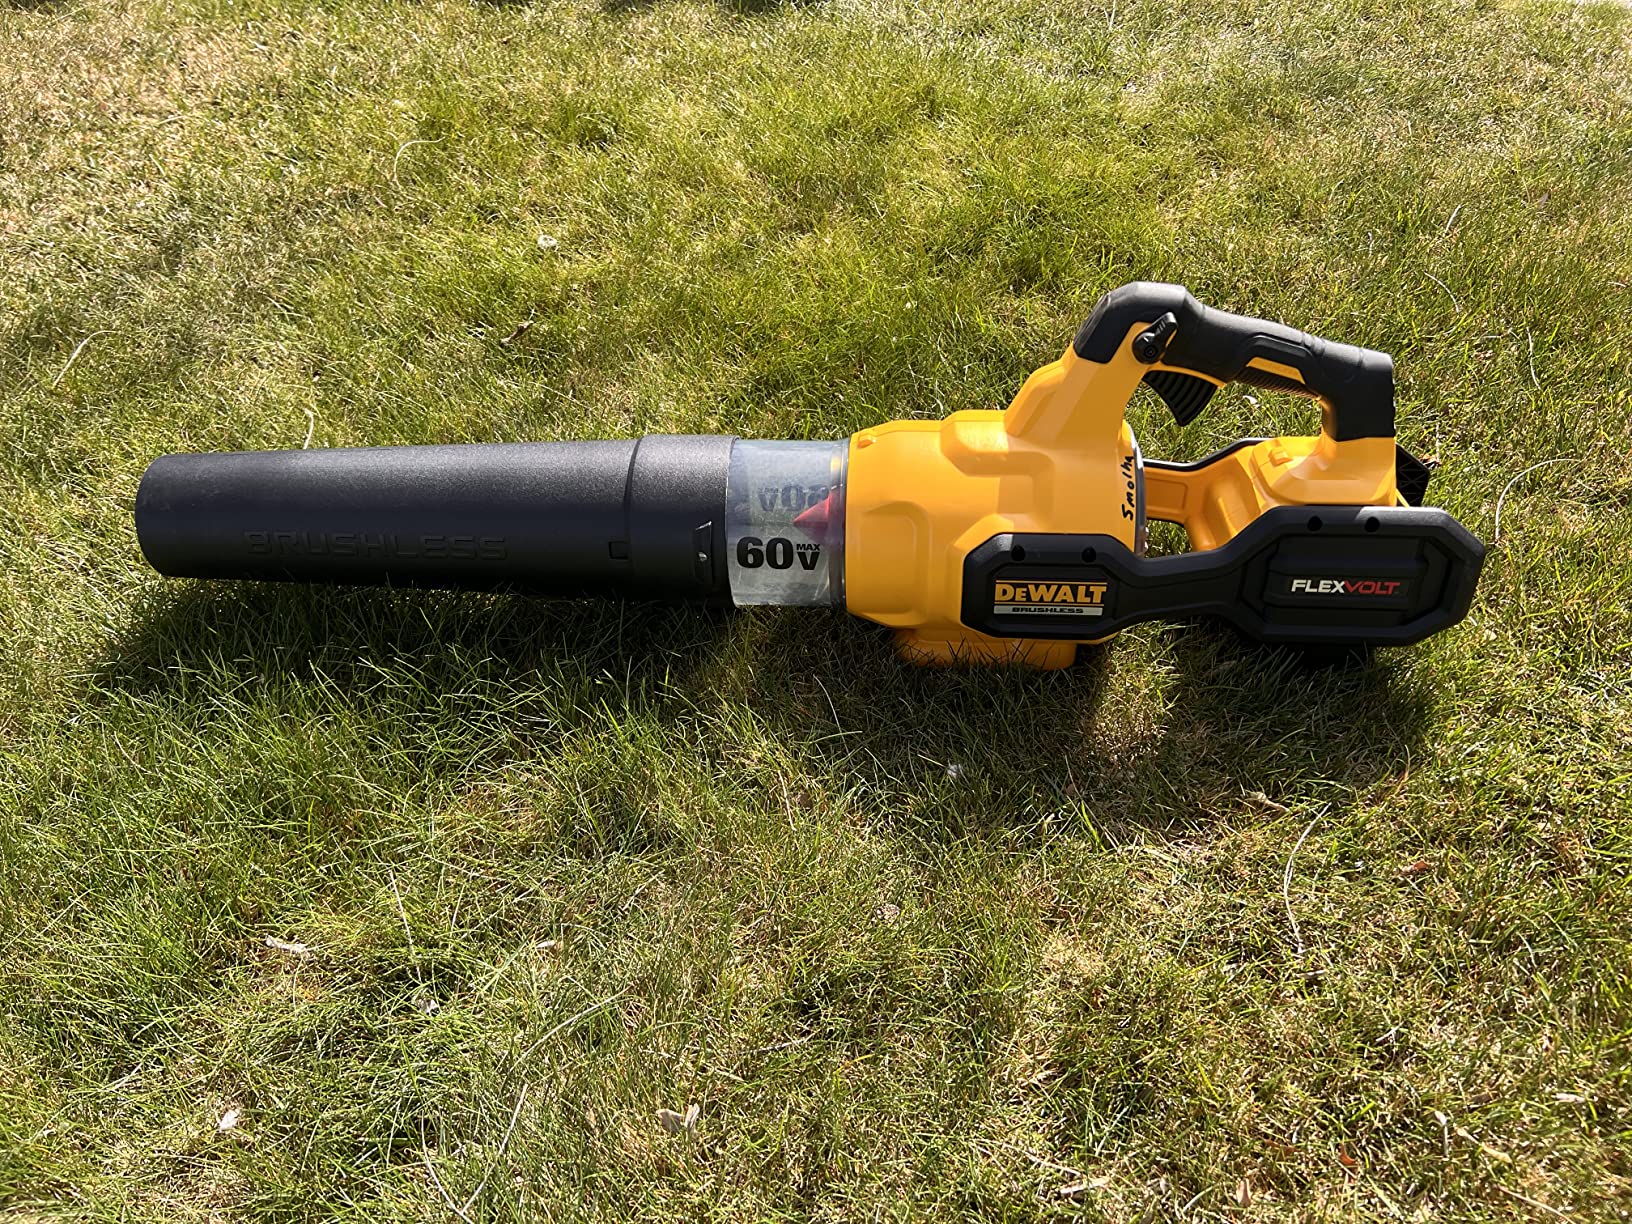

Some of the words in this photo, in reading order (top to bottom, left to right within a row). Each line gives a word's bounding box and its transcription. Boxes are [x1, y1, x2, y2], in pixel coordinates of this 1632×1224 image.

[244, 529, 508, 561] BRUSHLESS
[796, 543, 820, 551] MAX
[1291, 579, 1401, 595] FLEXVOLT
[1011, 606, 1084, 614] BRUSHLESS
